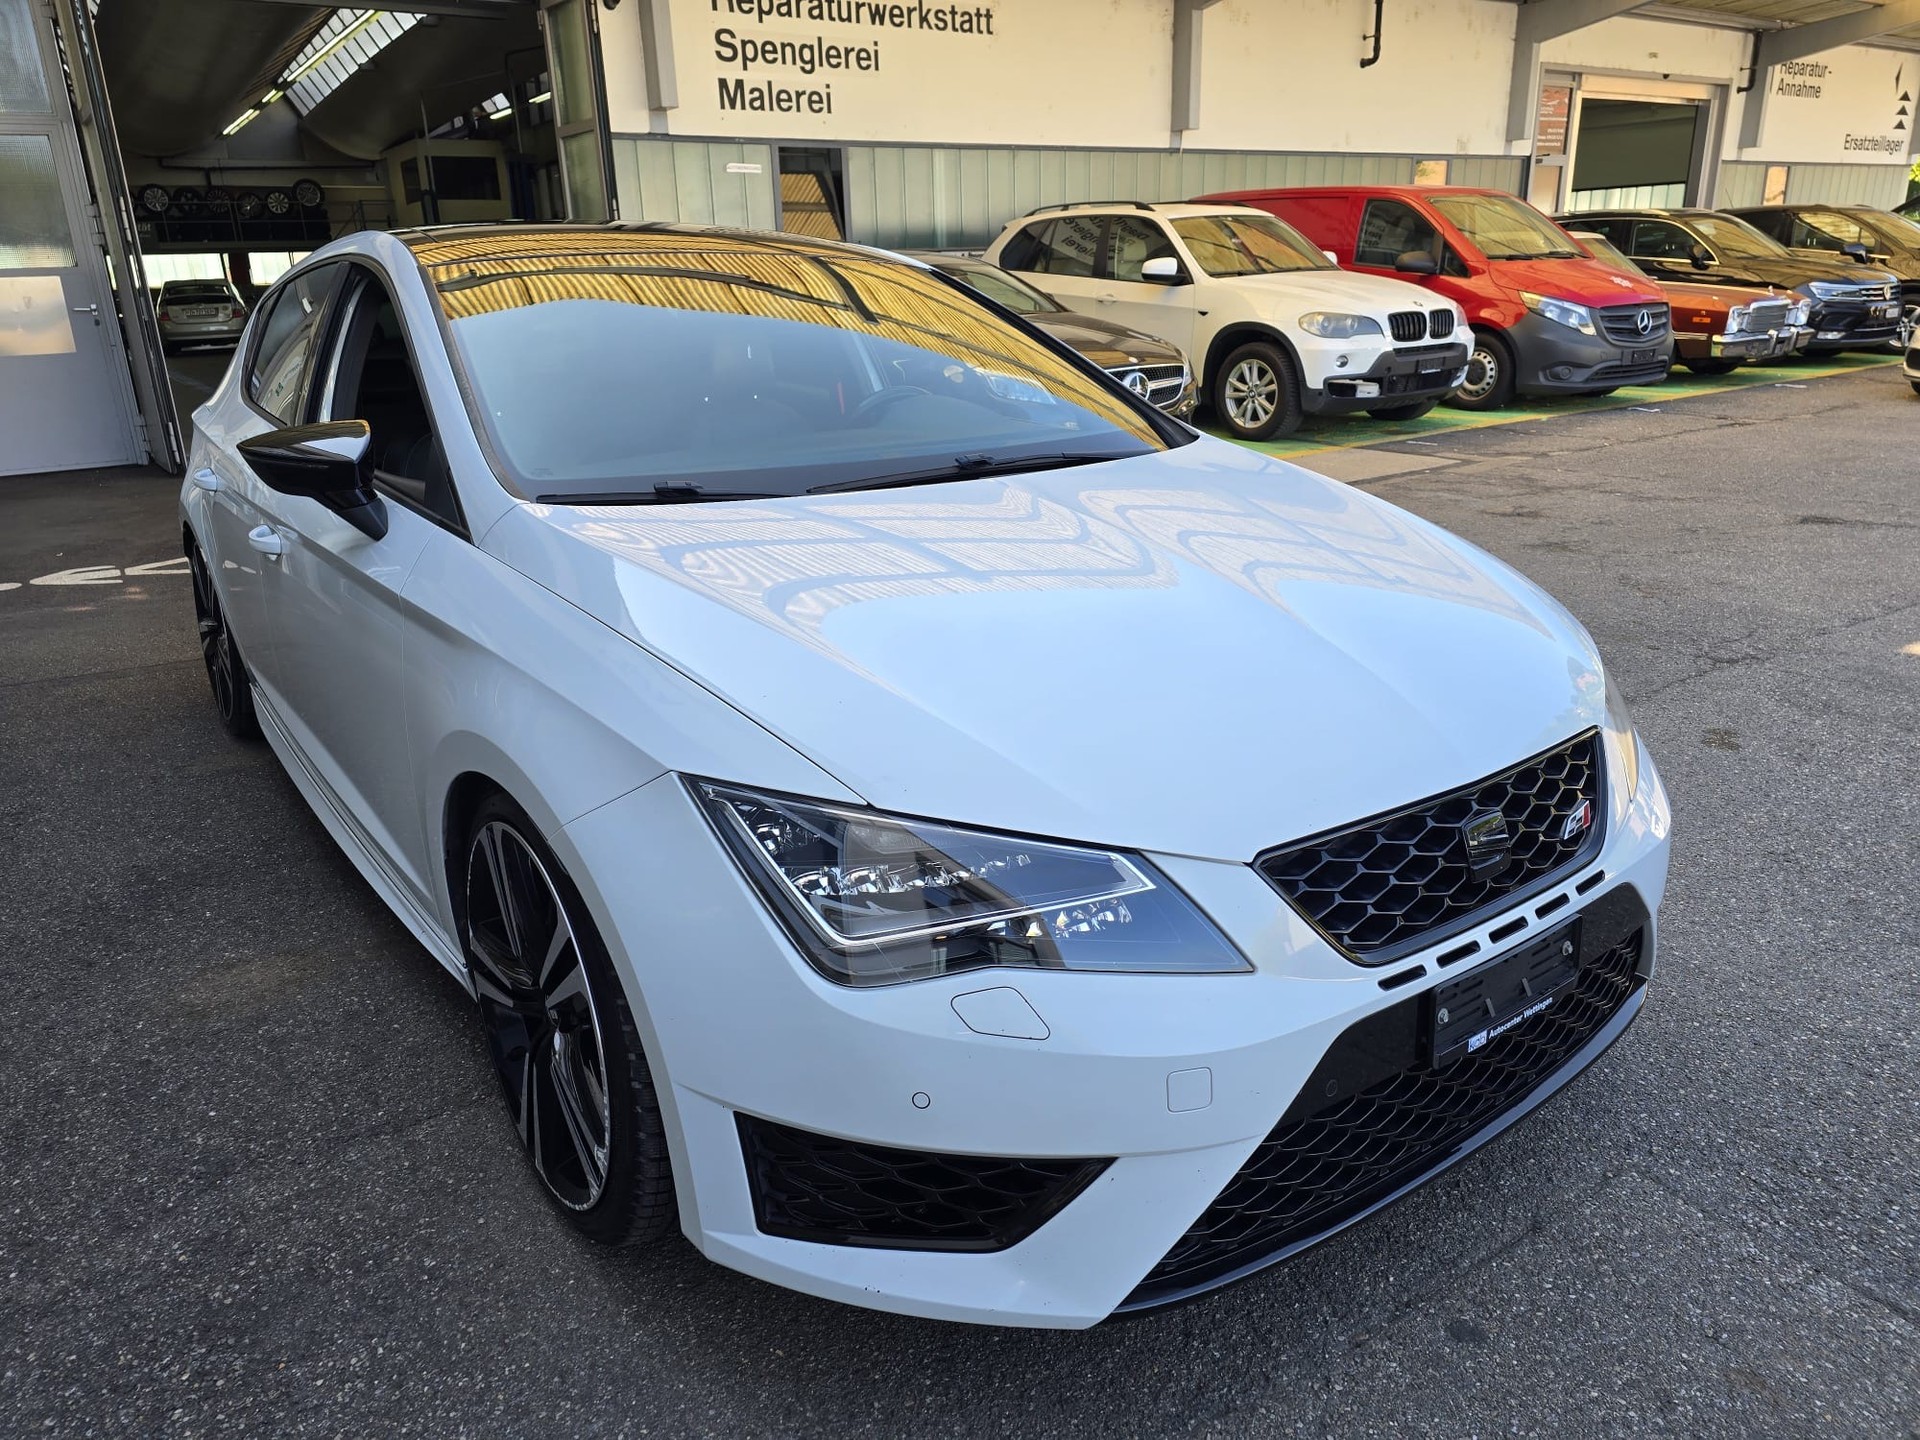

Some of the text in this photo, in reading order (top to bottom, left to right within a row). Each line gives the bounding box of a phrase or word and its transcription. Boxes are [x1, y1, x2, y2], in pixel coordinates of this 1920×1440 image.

[714, 28, 880, 75] Spenglerei
[717, 77, 832, 114] Malerei
[1776, 78, 1822, 99] Annahme
[1843, 133, 1905, 155] Ersatzteillager
[1488, 1014, 1523, 1040] Autocenter
[1523, 997, 1553, 1019] Wettingen
